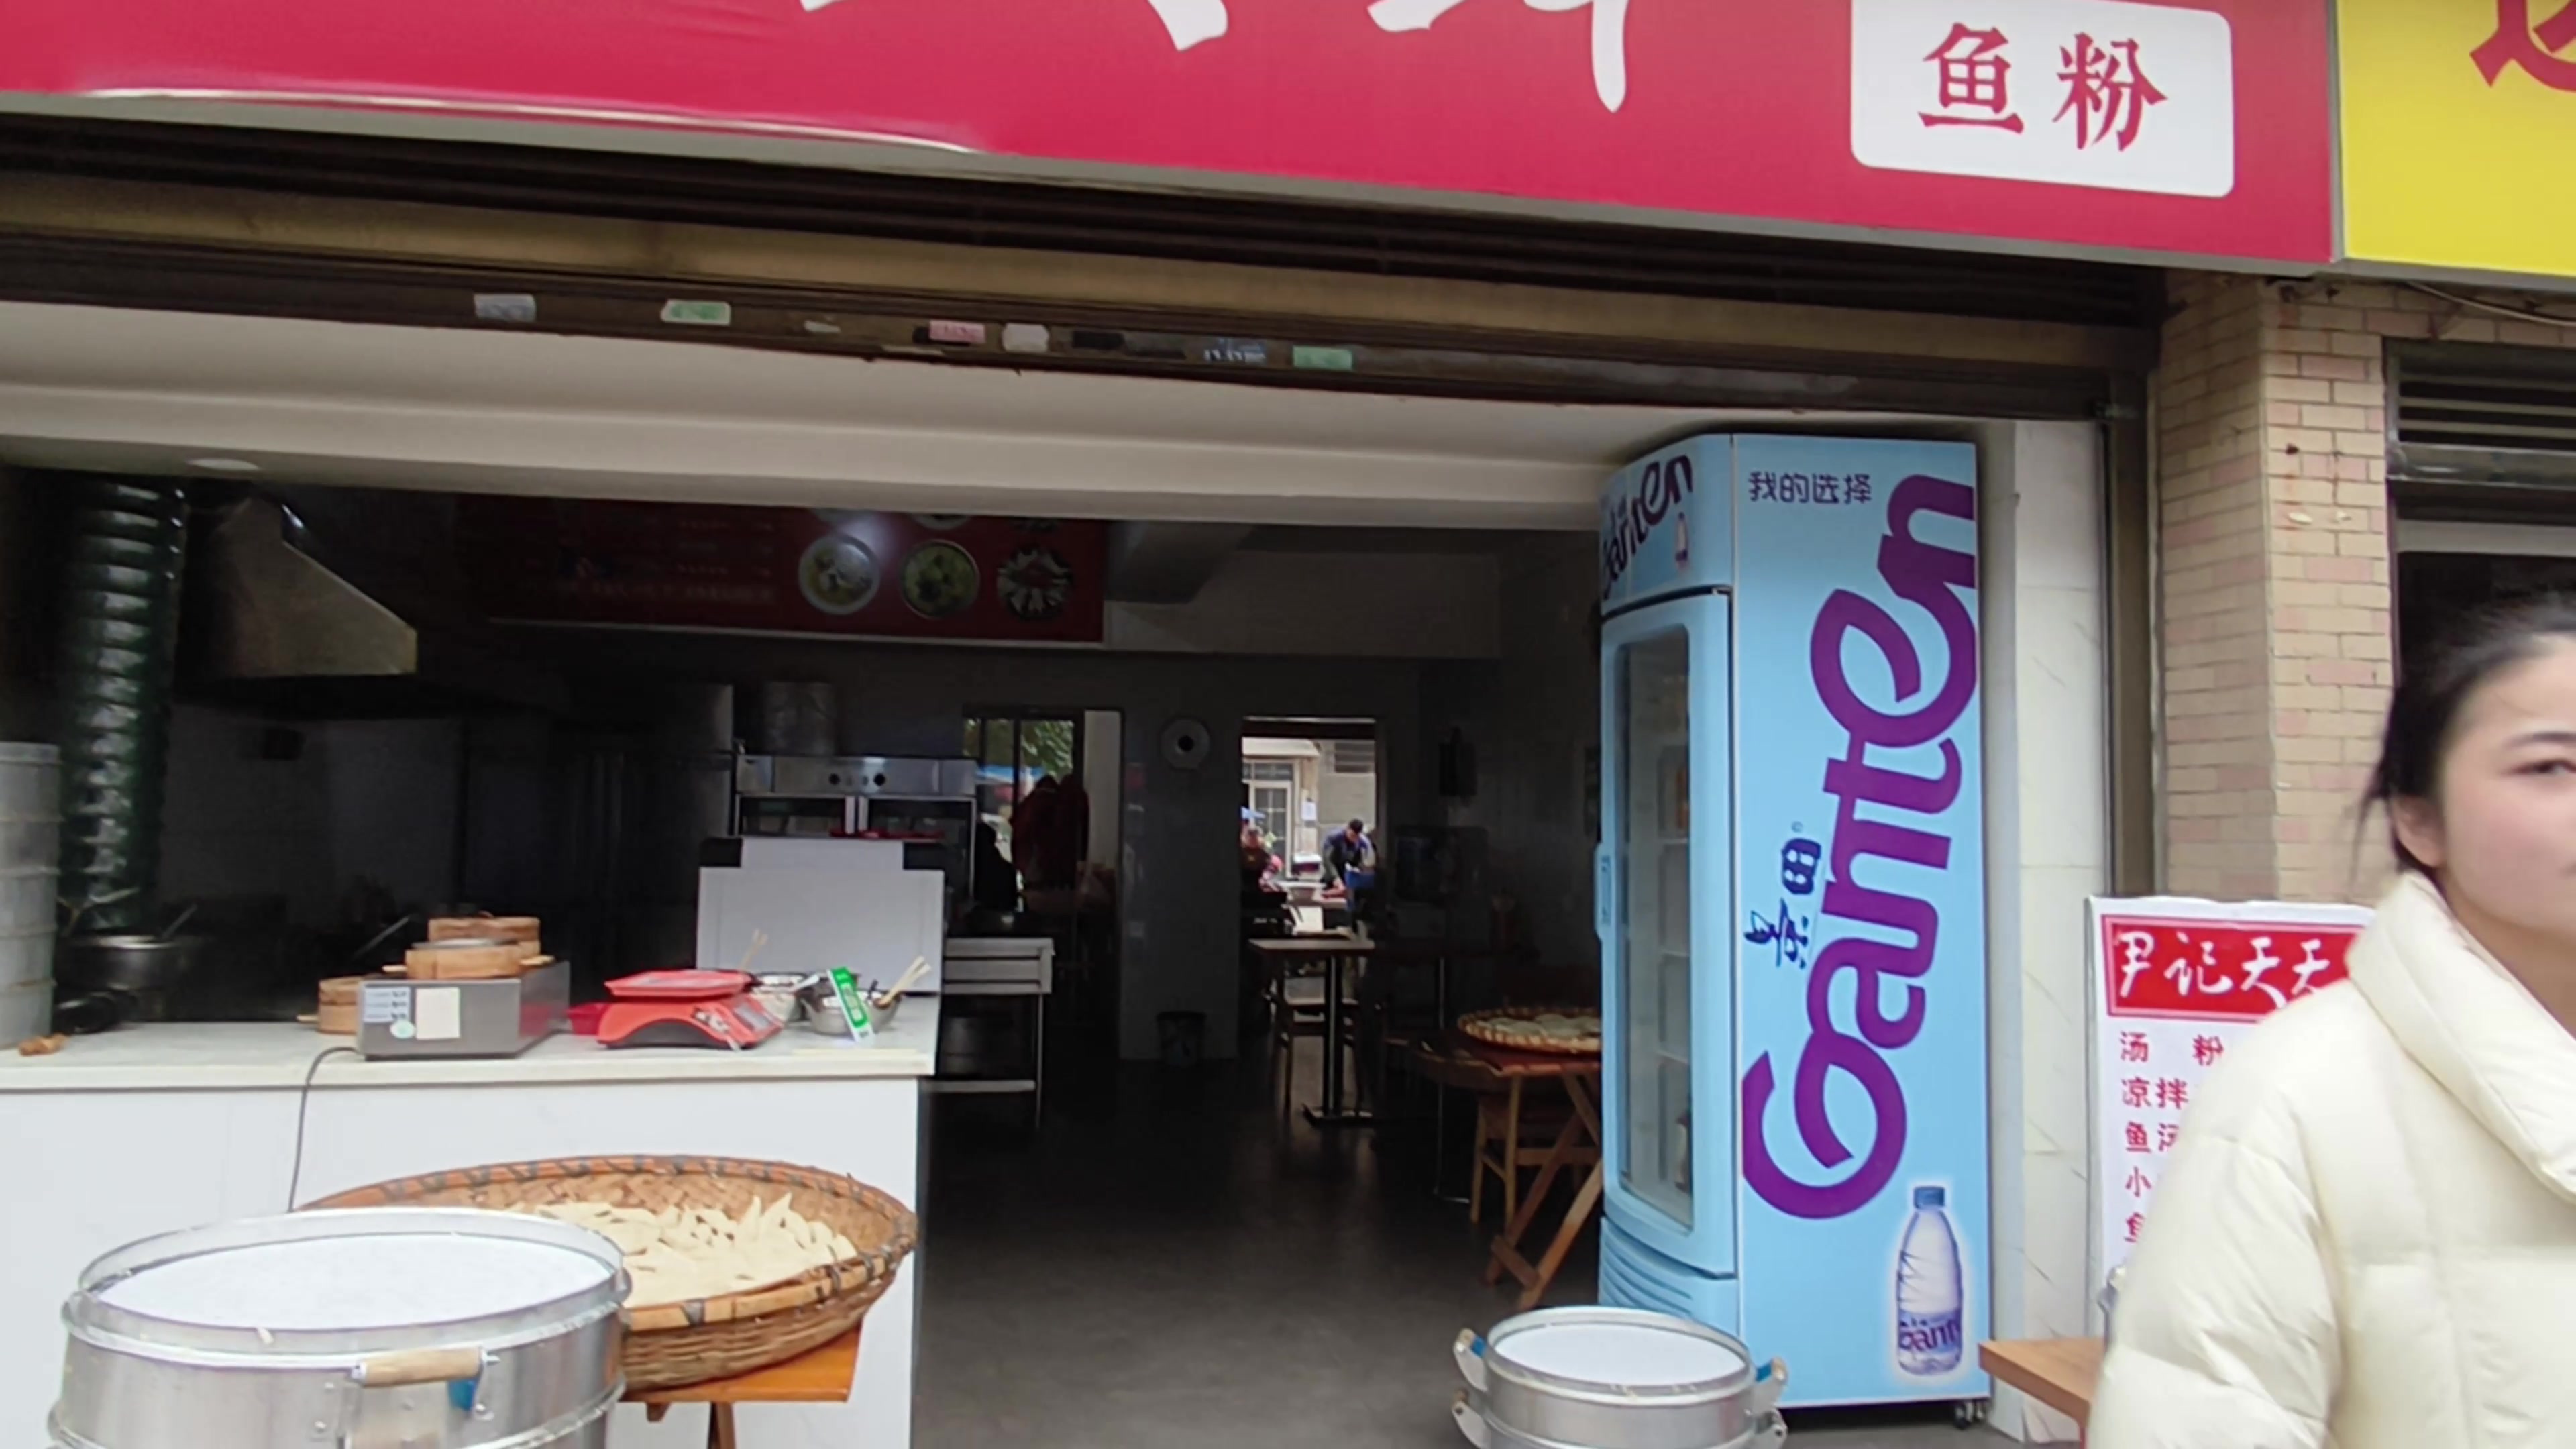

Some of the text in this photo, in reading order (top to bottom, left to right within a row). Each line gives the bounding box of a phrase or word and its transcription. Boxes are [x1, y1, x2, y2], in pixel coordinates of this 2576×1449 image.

[1917, 21, 2169, 152] 鱼粉
[1748, 470, 1872, 504] 我的选择
[1742, 474, 1979, 1220] Ganten
[2121, 1076, 2189, 1110] 凉拌
[2125, 1165, 2152, 1197] 小
